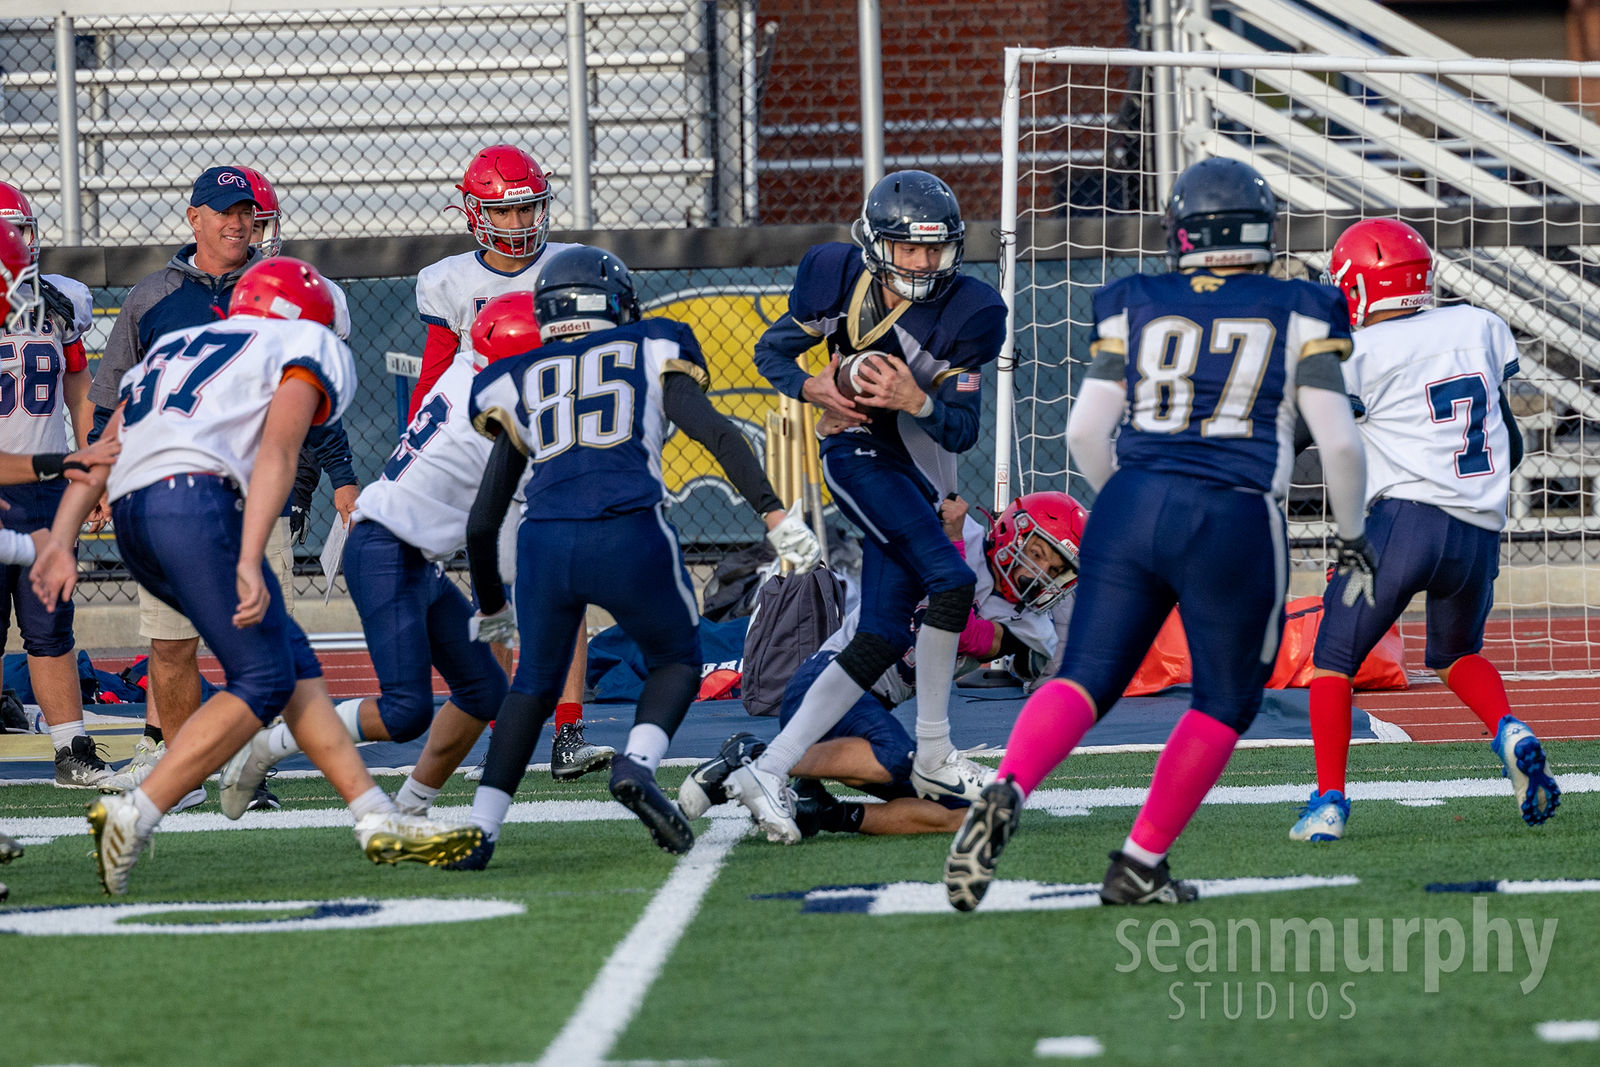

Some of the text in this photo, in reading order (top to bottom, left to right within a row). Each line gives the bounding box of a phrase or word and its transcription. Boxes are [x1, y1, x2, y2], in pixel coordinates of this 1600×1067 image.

[507, 187, 531, 197] Riddell
[549, 321, 591, 335] Riddell
[1131, 315, 1277, 438] 87
[522, 340, 638, 463] 85
[1425, 371, 1496, 479] 7
